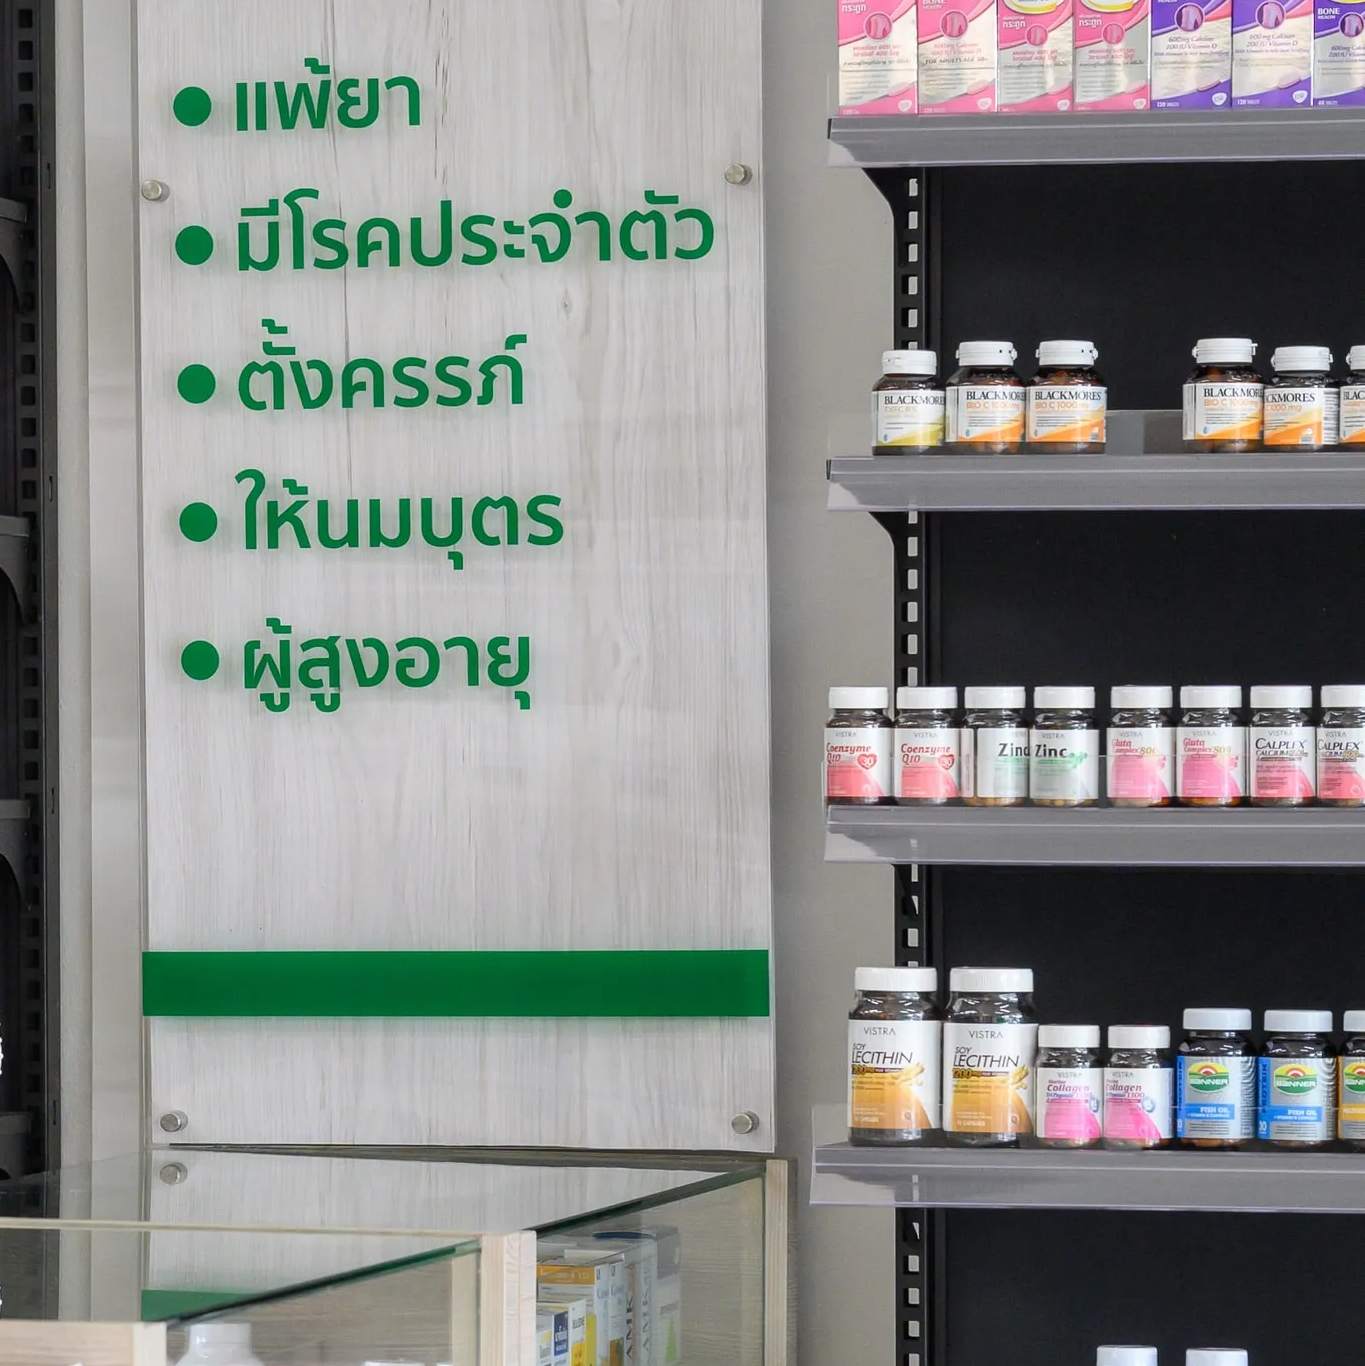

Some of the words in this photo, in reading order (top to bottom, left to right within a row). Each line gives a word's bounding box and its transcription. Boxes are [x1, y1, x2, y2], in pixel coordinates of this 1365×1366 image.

[1317, 7, 1340, 15] BONE
[234, 57, 422, 132] แพ้ยา
[236, 188, 716, 273] มีโรคประจำตัว
[237, 318, 528, 412] ตั้งครรภ์
[1034, 390, 1102, 401] BLACKMORES
[1203, 399, 1219, 407] BIO
[234, 468, 565, 571] ให้นมบุตร
[242, 617, 532, 714] ผู้สูงอายุ
[900, 742, 951, 756] Coenzyme
[1255, 737, 1307, 750] CALPLEX
[1034, 744, 1067, 758] Zinc
[901, 754, 921, 765] Q10
[863, 1026, 896, 1036] VISTRA
[969, 1030, 1004, 1040] VISTRA
[955, 1046, 972, 1054] SOY
[851, 1051, 913, 1065] LECITHIN
[953, 1054, 1020, 1068] LECITHIN
[1046, 1084, 1090, 1094] Collagen
